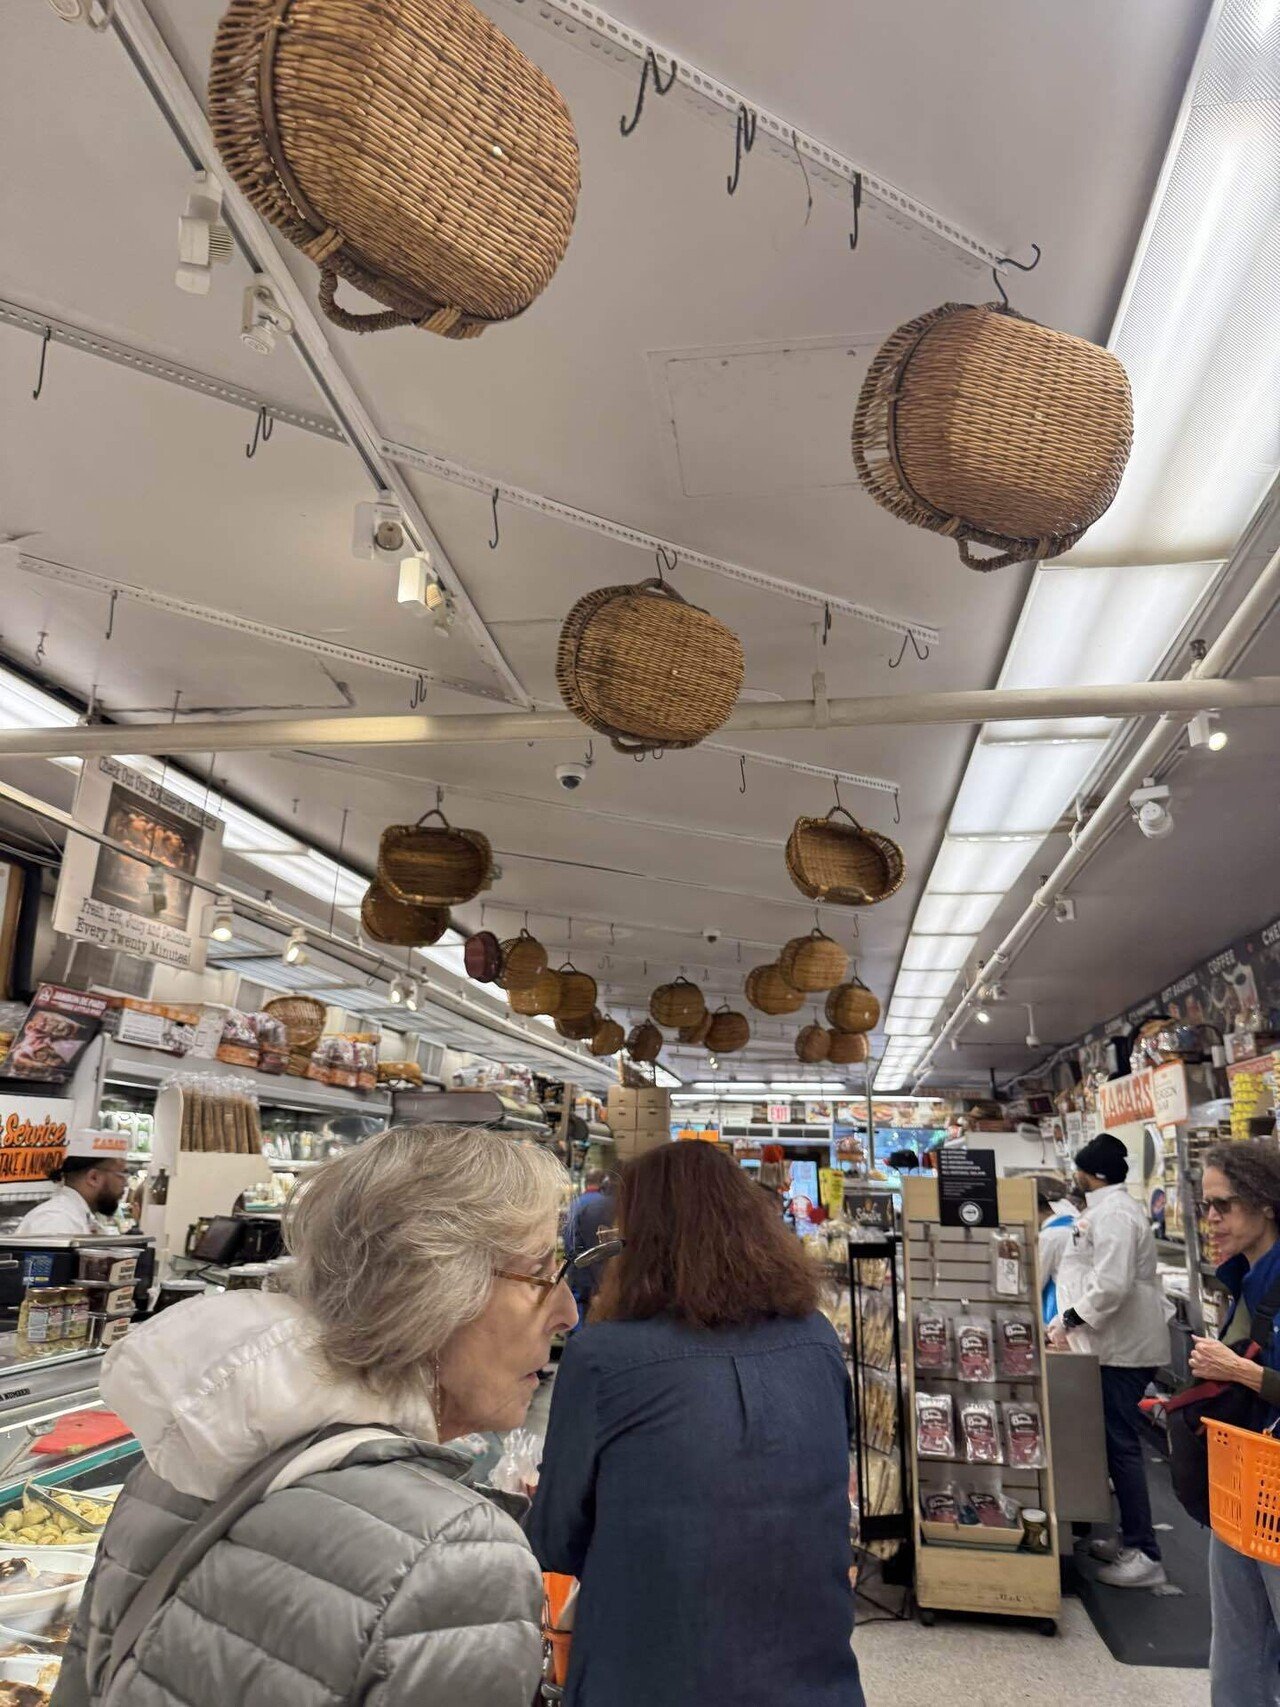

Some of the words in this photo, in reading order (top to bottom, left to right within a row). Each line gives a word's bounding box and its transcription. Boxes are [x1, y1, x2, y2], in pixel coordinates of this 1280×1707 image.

[75, 916, 109, 943] Every
[109, 928, 148, 955] Twenty
[148, 940, 192, 966] Minutes!
[1208, 949, 1235, 975] COFFEE
